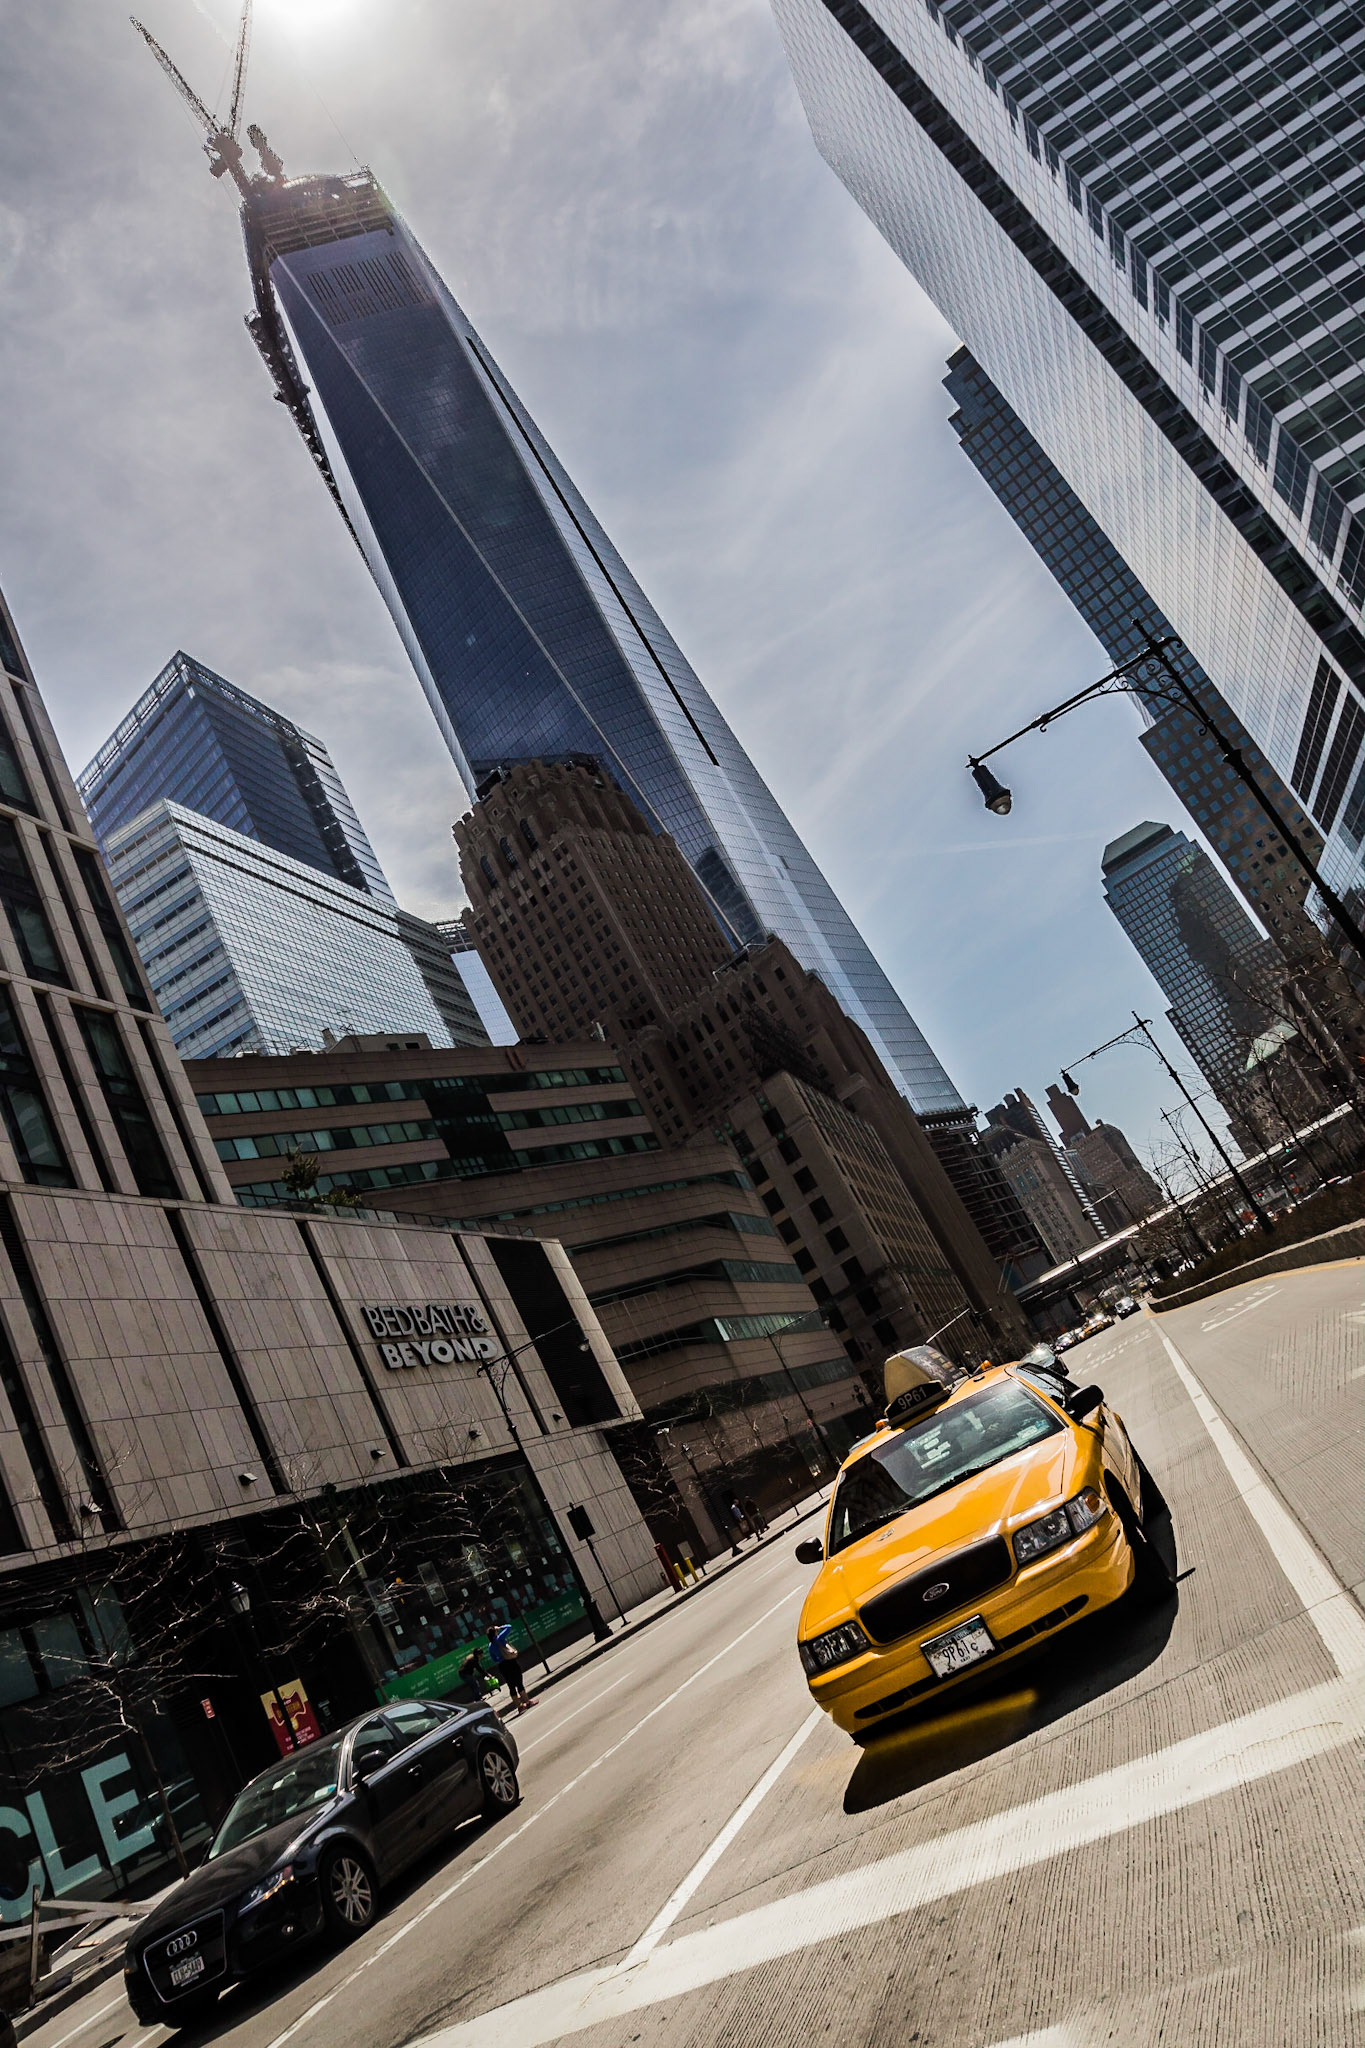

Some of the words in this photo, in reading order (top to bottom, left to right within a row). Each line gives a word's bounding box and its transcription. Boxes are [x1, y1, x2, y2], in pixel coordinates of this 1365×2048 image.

[361, 1305, 415, 1338] BED
[410, 1304, 471, 1335] BATH
[466, 1304, 490, 1333] &
[379, 1337, 498, 1370] BEYOND
[897, 1387, 927, 1410] 9P61
